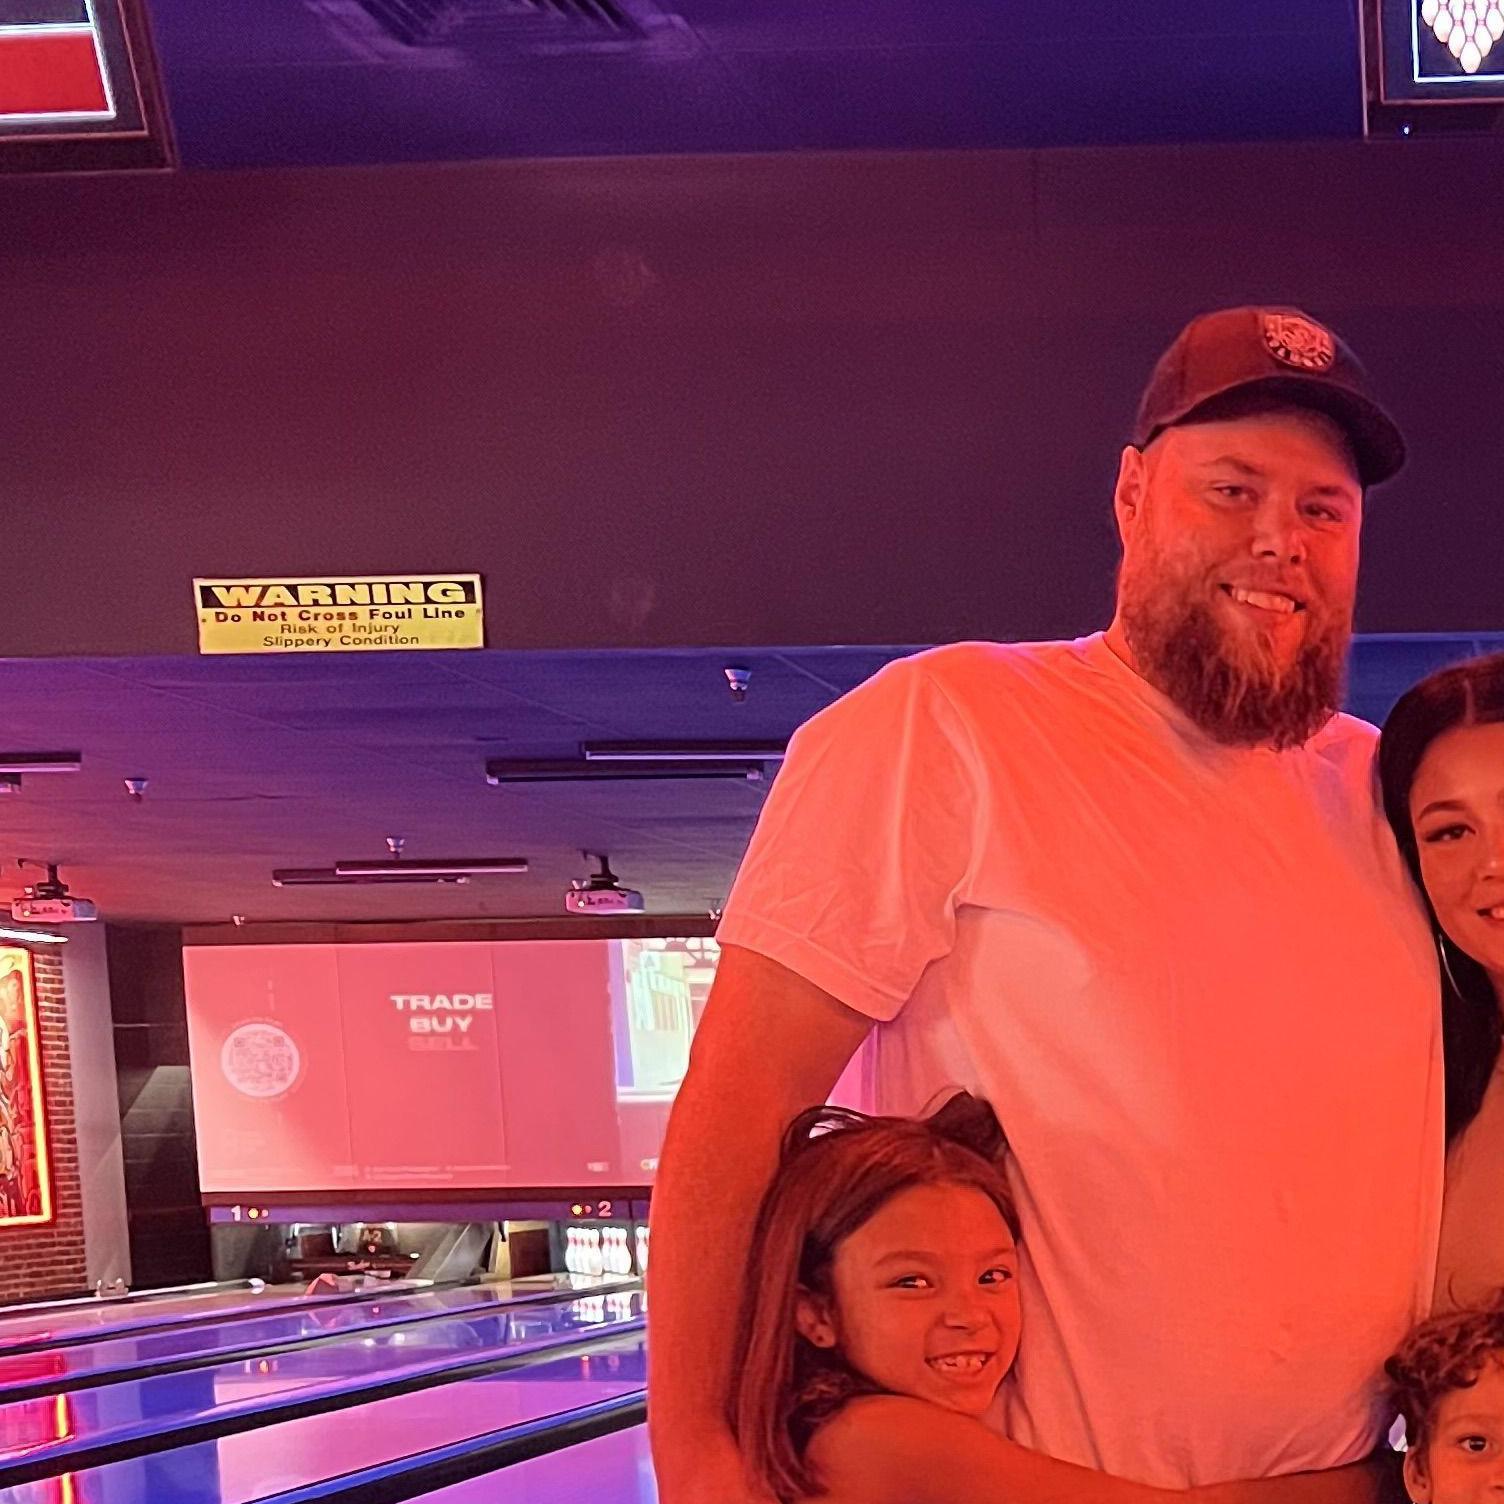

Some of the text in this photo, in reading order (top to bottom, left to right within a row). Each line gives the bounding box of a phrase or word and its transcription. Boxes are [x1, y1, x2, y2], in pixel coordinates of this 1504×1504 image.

[211, 582, 466, 607] WARNING
[215, 607, 466, 623] Do Not Cross Foul Line
[280, 622, 400, 635] Risk of Injury
[263, 634, 420, 648] Slippery Condition
[390, 993, 493, 1011] TRADE
[409, 1014, 473, 1033] BUY
[231, 1205, 241, 1222] 1
[598, 1200, 612, 1217] 2
